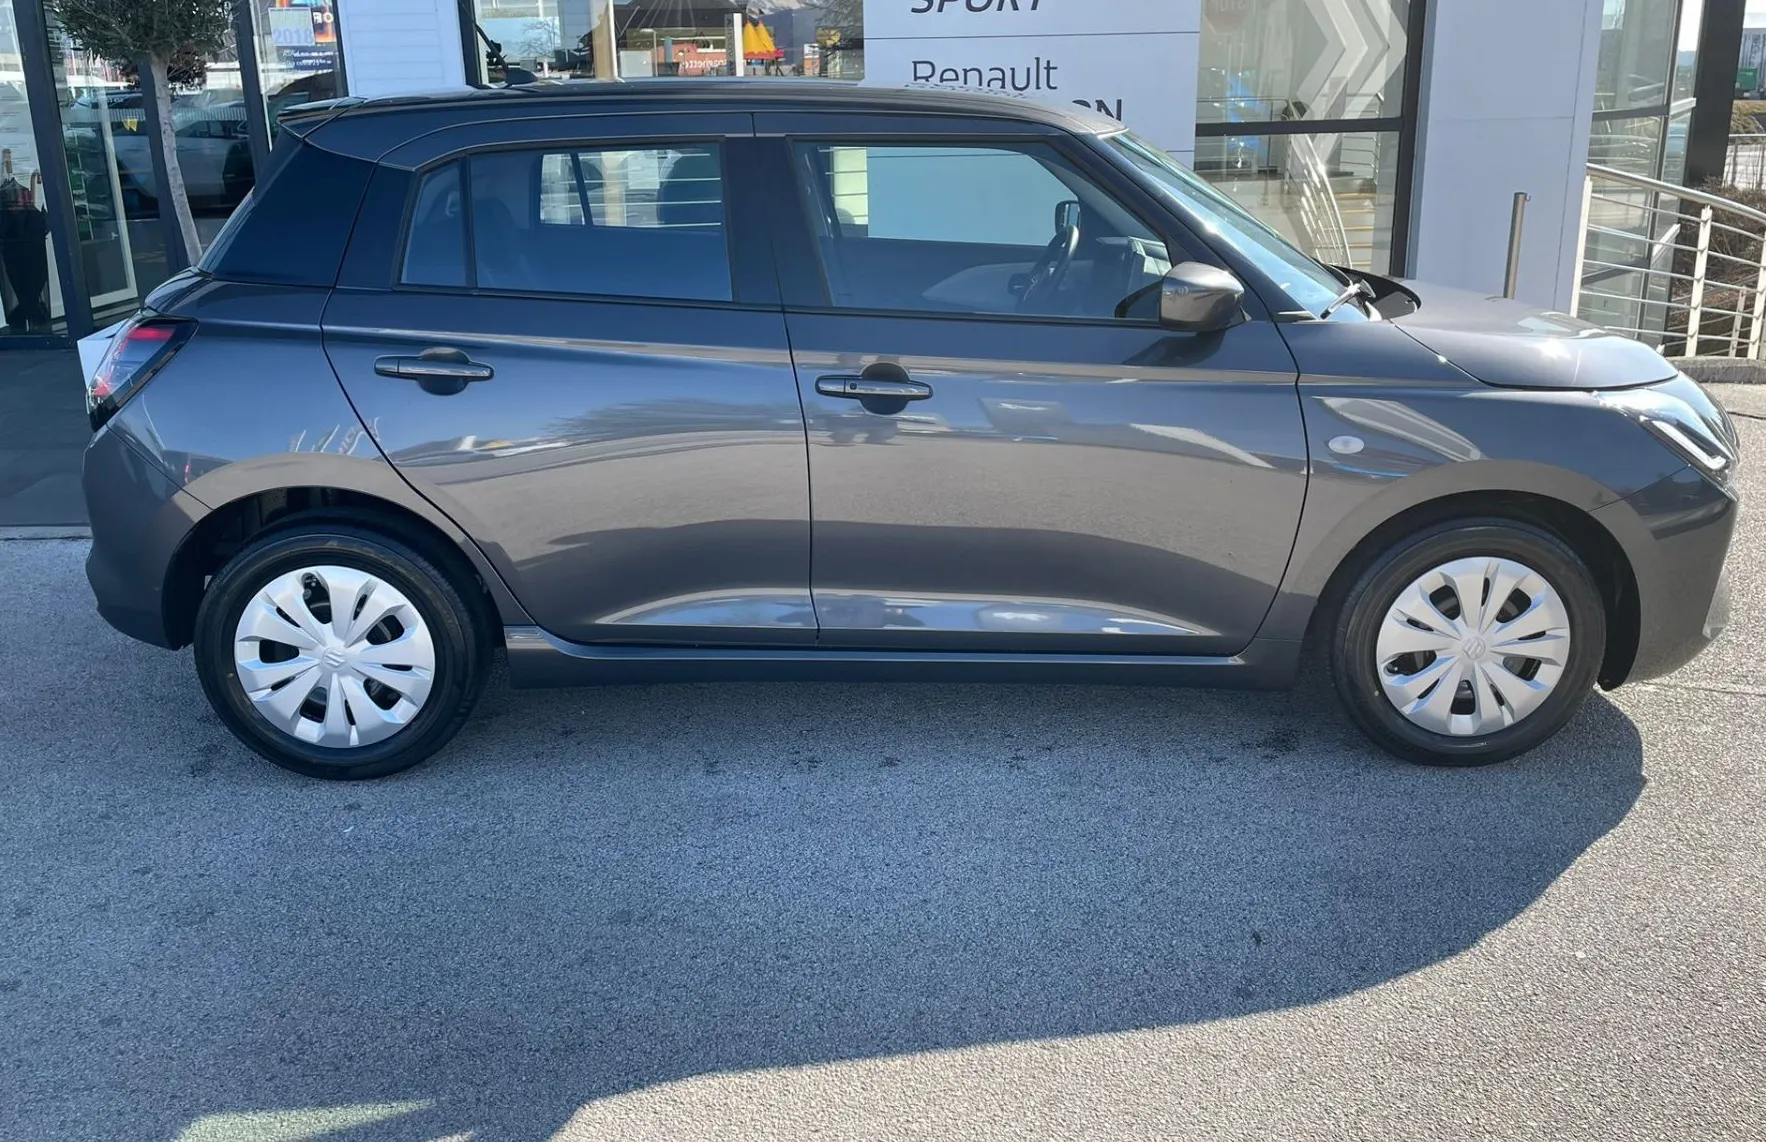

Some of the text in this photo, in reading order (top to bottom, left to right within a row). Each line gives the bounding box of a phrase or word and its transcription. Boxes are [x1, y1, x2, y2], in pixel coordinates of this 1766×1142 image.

[911, 0, 1040, 13] SPOR
[273, 28, 313, 44] 2018
[912, 57, 1058, 91] Renault
